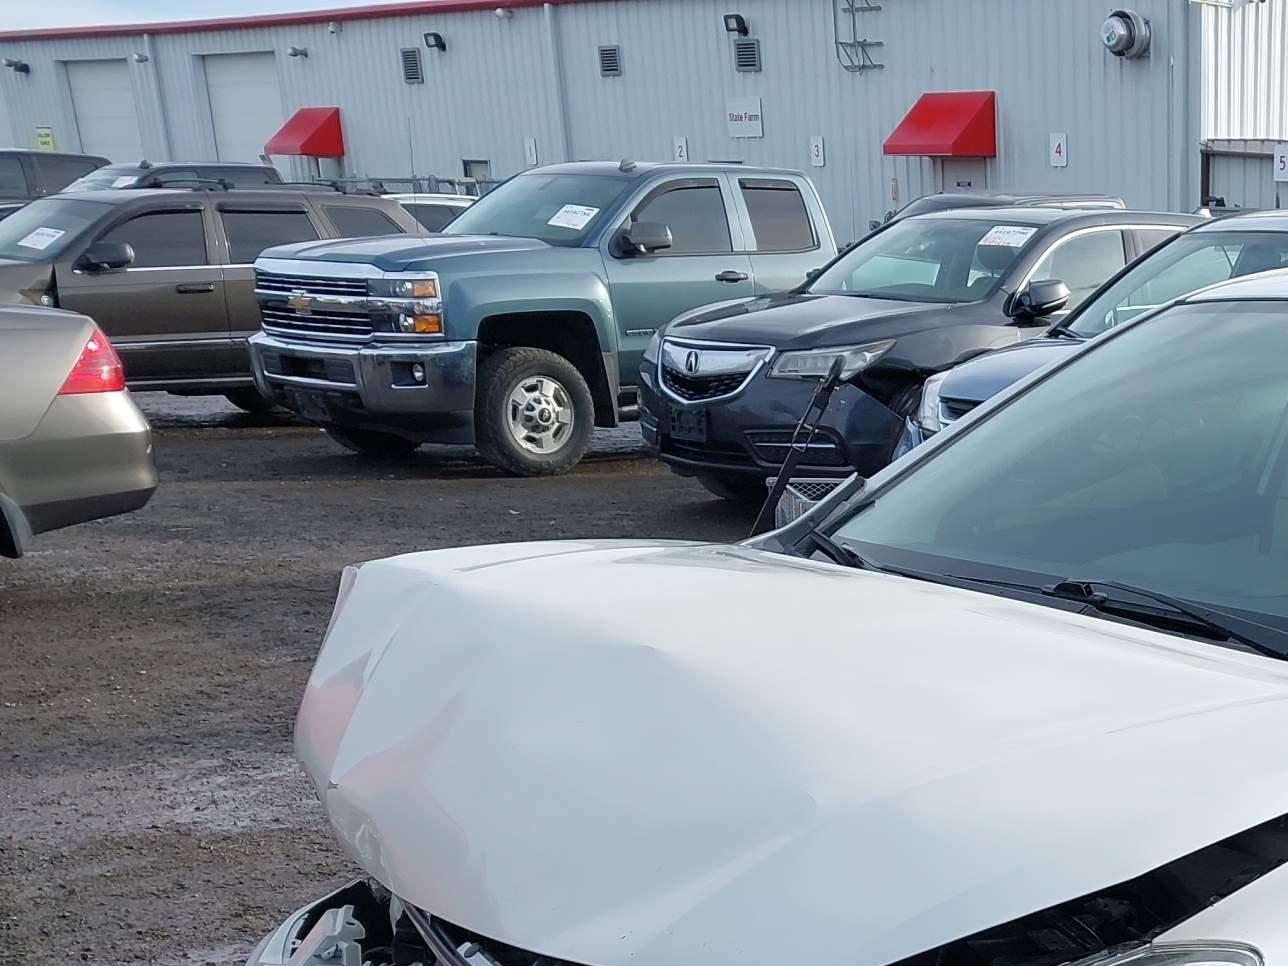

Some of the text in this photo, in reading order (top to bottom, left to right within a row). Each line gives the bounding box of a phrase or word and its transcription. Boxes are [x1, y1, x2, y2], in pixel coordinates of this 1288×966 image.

[744, 112, 760, 122] Farm
[678, 145, 684, 157] 2
[814, 144, 820, 157] 3
[1055, 142, 1062, 156] 4
[1279, 155, 1286, 171] 5
